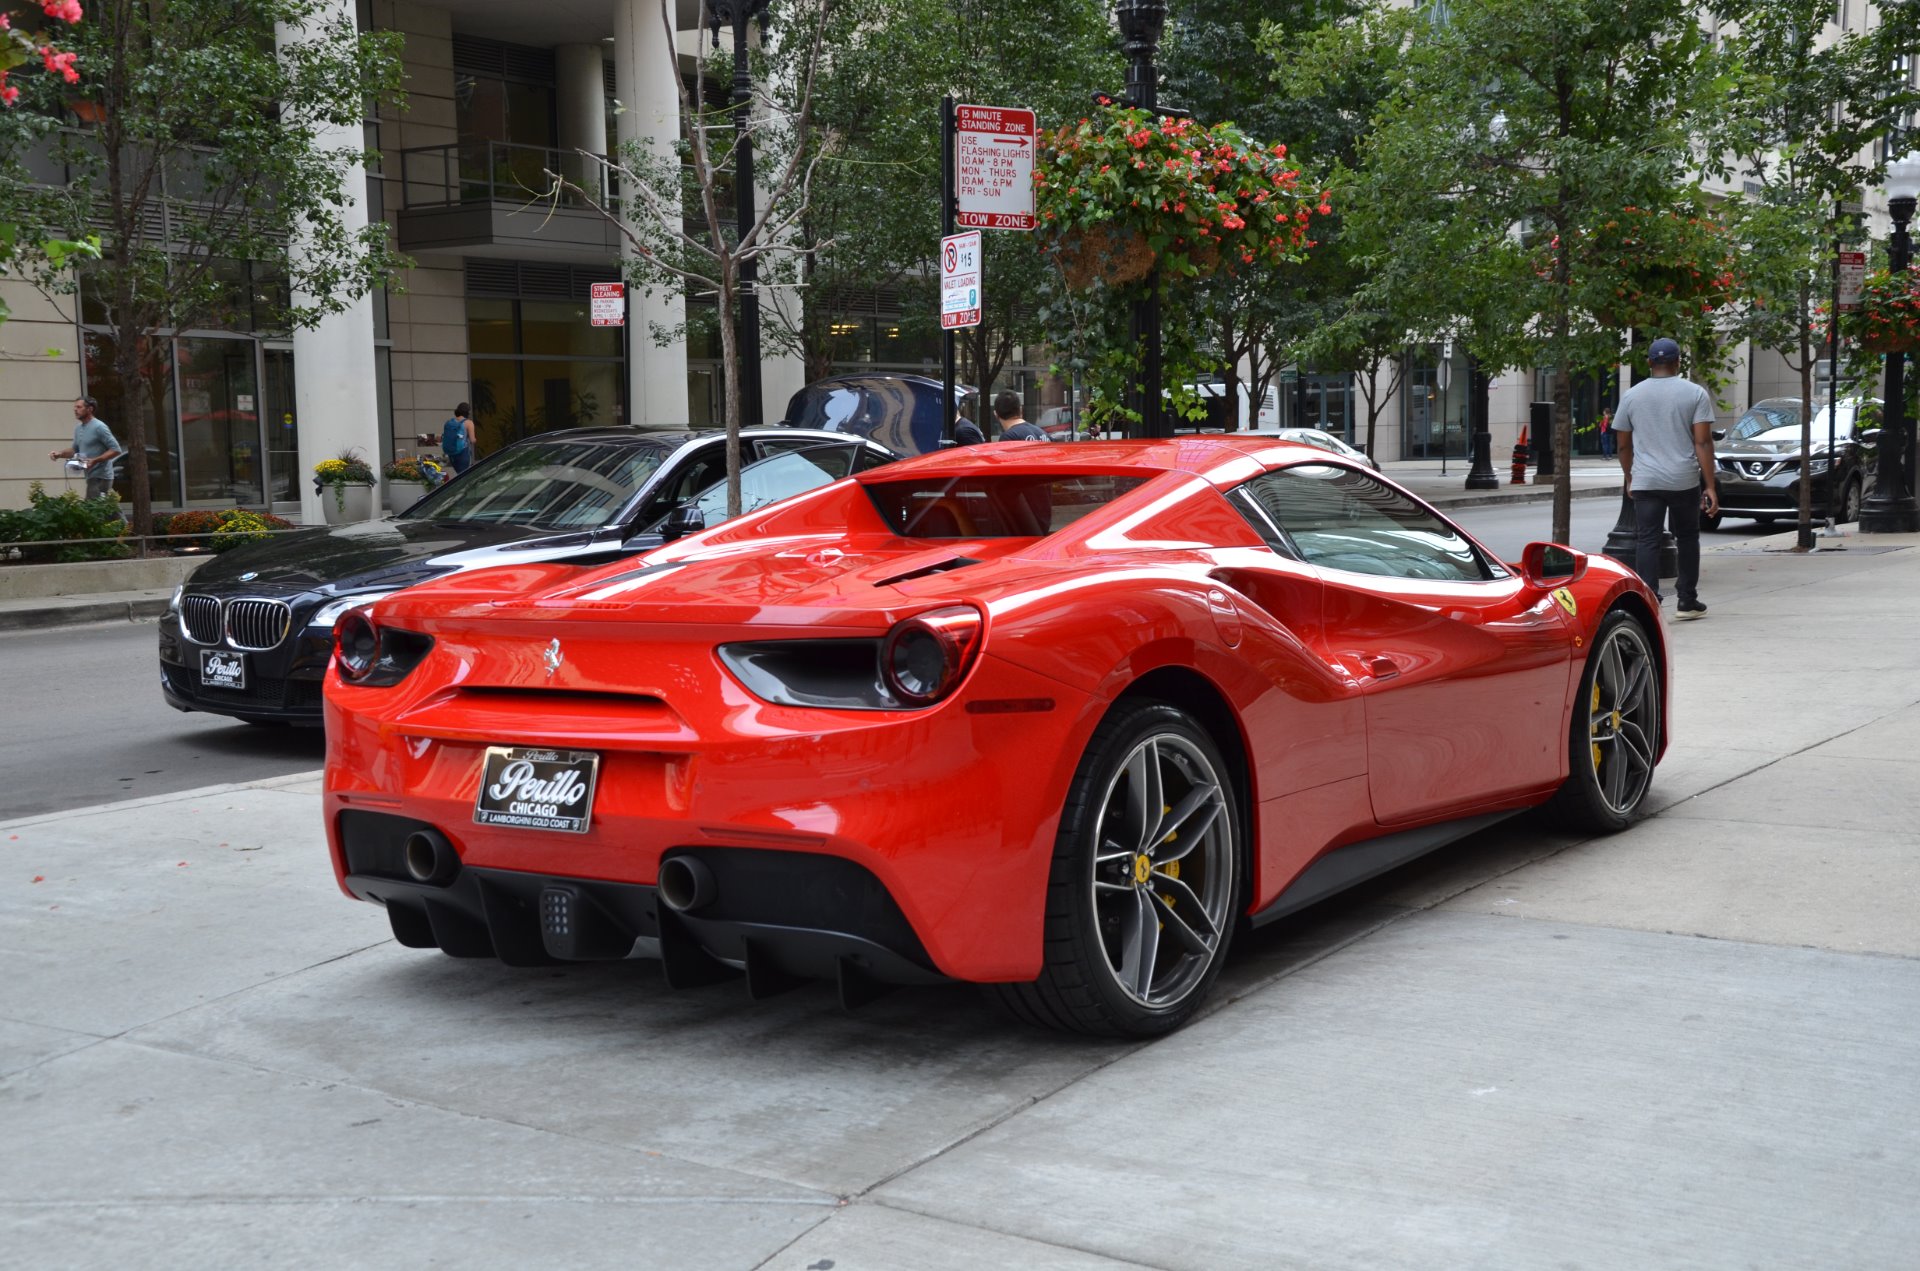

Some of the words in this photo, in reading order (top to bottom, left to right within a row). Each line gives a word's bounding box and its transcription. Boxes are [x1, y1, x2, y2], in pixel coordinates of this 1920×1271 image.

[961, 109, 970, 118] 15
[972, 110, 1002, 120] MINUTE
[962, 120, 1000, 131] STANDING
[1004, 123, 1026, 133] ZONE
[962, 136, 978, 145] USE
[962, 146, 1001, 157] FLASHING
[1002, 149, 1030, 159] LIGHTS
[992, 158, 998, 166] 8
[1001, 159, 1013, 167] PM
[962, 167, 980, 175] MON
[989, 168, 1016, 178] THURS
[992, 178, 998, 187] 6
[1000, 179, 1012, 188] PM
[962, 187, 976, 196] FRI
[983, 188, 1001, 197] SUN
[962, 213, 988, 225] TOW
[995, 215, 1028, 227] ZONE
[944, 280, 956, 290] VALET
[958, 276, 976, 288] LOADING
[944, 314, 957, 326] TOW
[960, 311, 976, 324] ZONE
[205, 656, 242, 677] Perillo
[522, 750, 559, 761] Perillo
[489, 760, 586, 806] Perillo
[509, 801, 558, 817] CHICAGO
[489, 814, 532, 825] LAMBORGHINI
[532, 817, 549, 827] GOLD
[550, 818, 571, 829] COAST
